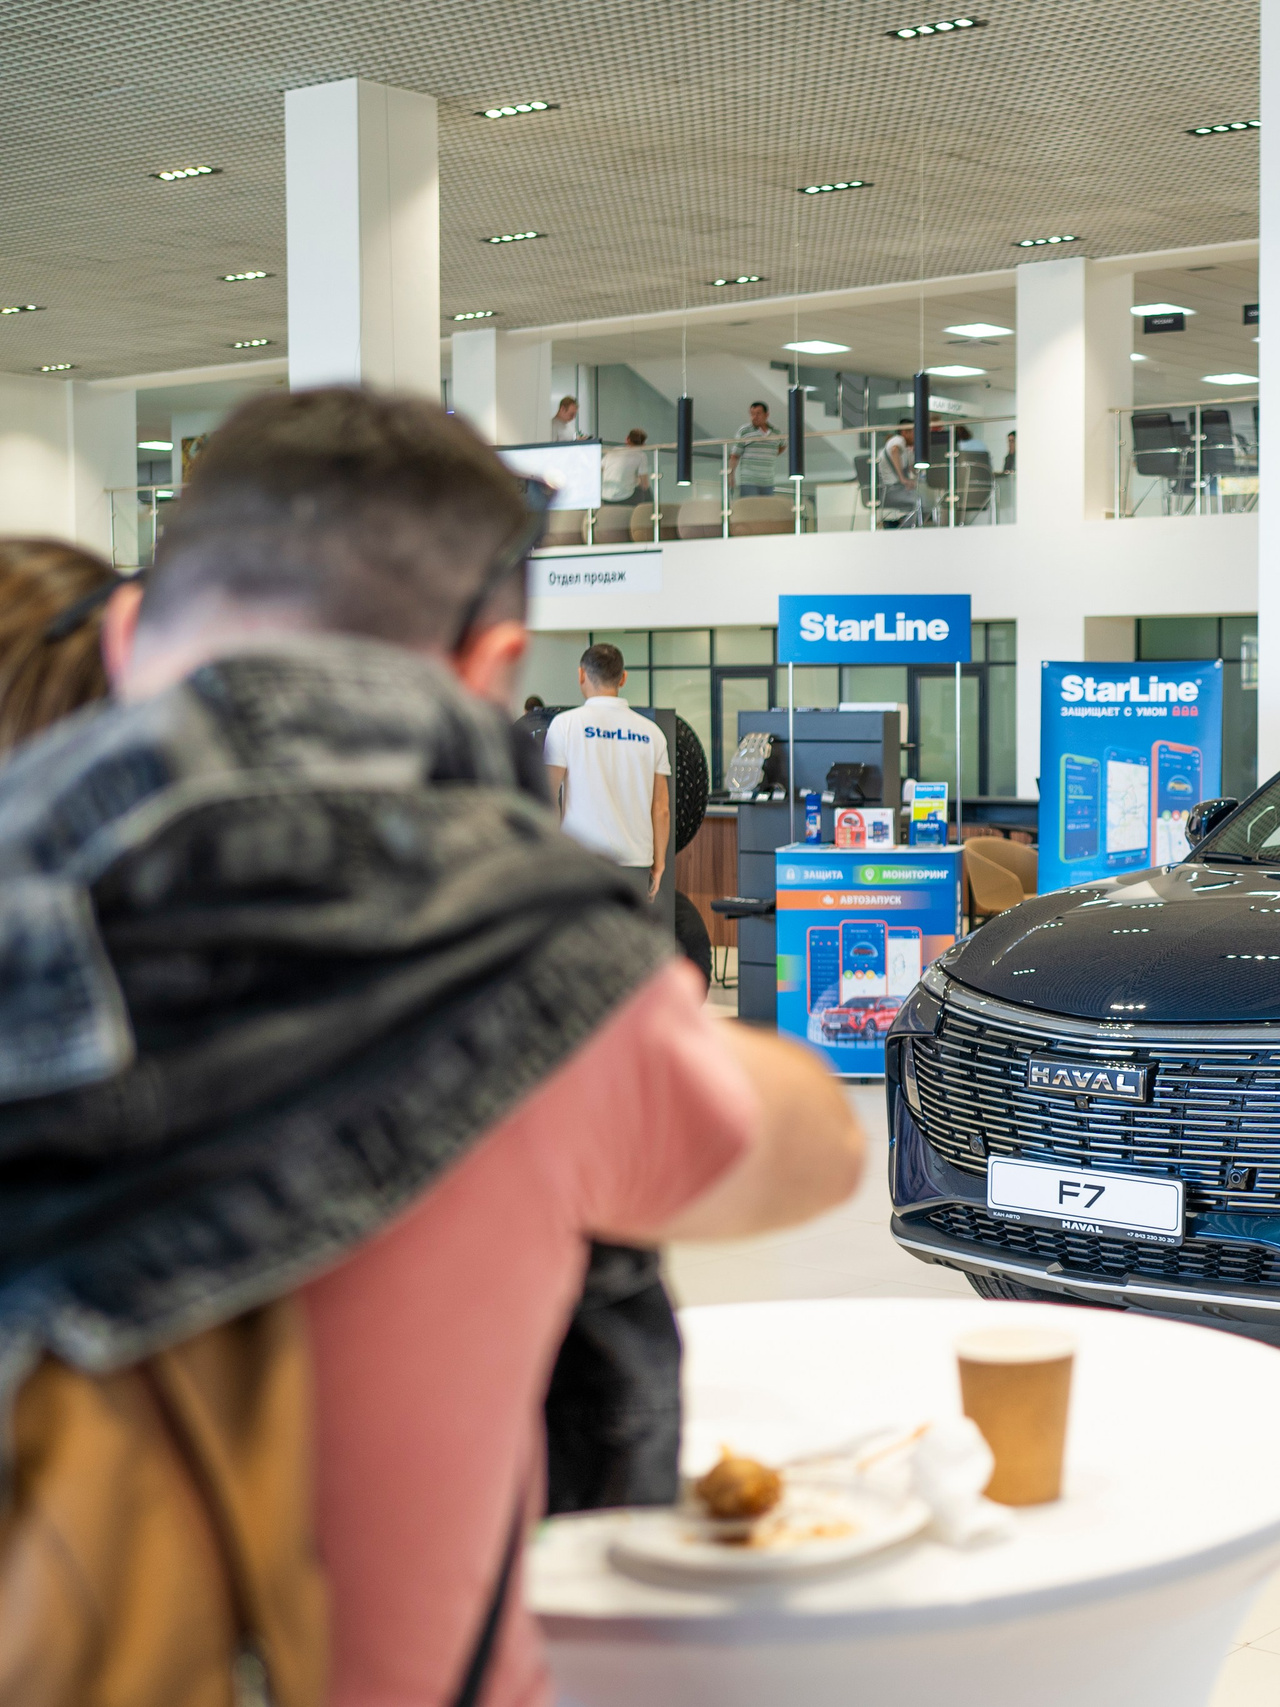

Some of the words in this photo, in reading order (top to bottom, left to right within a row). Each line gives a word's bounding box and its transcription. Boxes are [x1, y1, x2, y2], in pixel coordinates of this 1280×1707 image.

[548, 570, 581, 587] Отдел
[583, 570, 626, 587] продаж
[799, 611, 950, 642] StarLine
[1060, 674, 1200, 703] StarLine
[1060, 706, 1120, 718] ЗАЩИЩАЕТ
[1135, 706, 1168, 717] УМОМ
[584, 726, 651, 744] StarLine
[803, 869, 844, 881] ЗАЩИТА
[882, 869, 949, 880] МОНИТОРИНГ
[840, 894, 902, 906] АВТОЗАПУСК
[1031, 1066, 1136, 1094] HAVAL
[1058, 1179, 1106, 1209] F7
[1062, 1220, 1103, 1233] HAVAL
